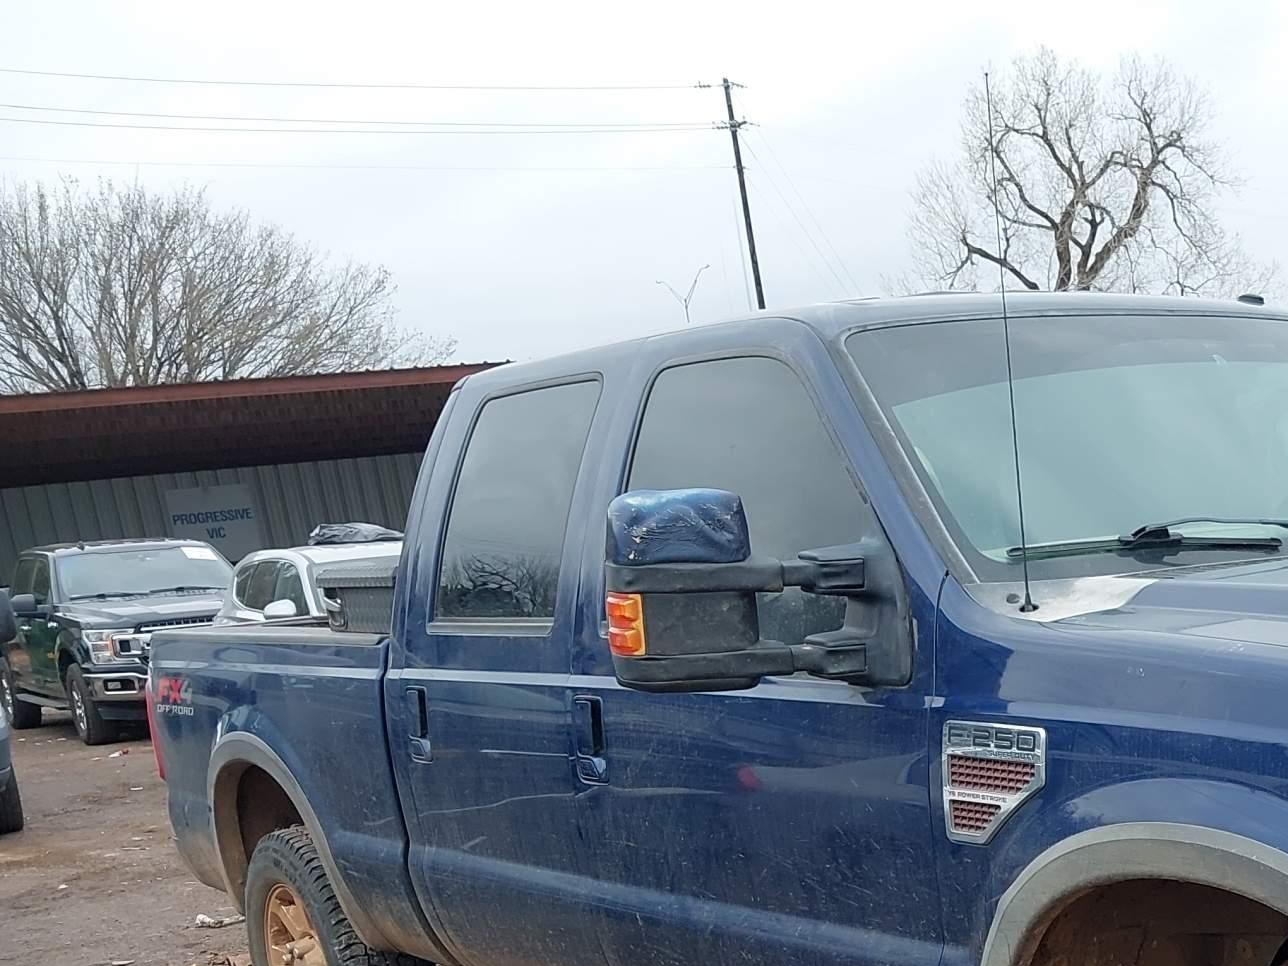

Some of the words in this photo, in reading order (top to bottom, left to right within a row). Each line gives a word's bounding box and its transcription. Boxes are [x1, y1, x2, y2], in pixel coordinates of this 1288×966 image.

[172, 508, 253, 526] PROGRESSIVE
[206, 527, 227, 539] VIC
[158, 677, 193, 704] FX4
[157, 704, 171, 713] OFF
[171, 705, 194, 716] ROAD
[948, 726, 1036, 752] F-250
[957, 791, 980, 799] POWER
[981, 794, 1008, 803] STROKE
